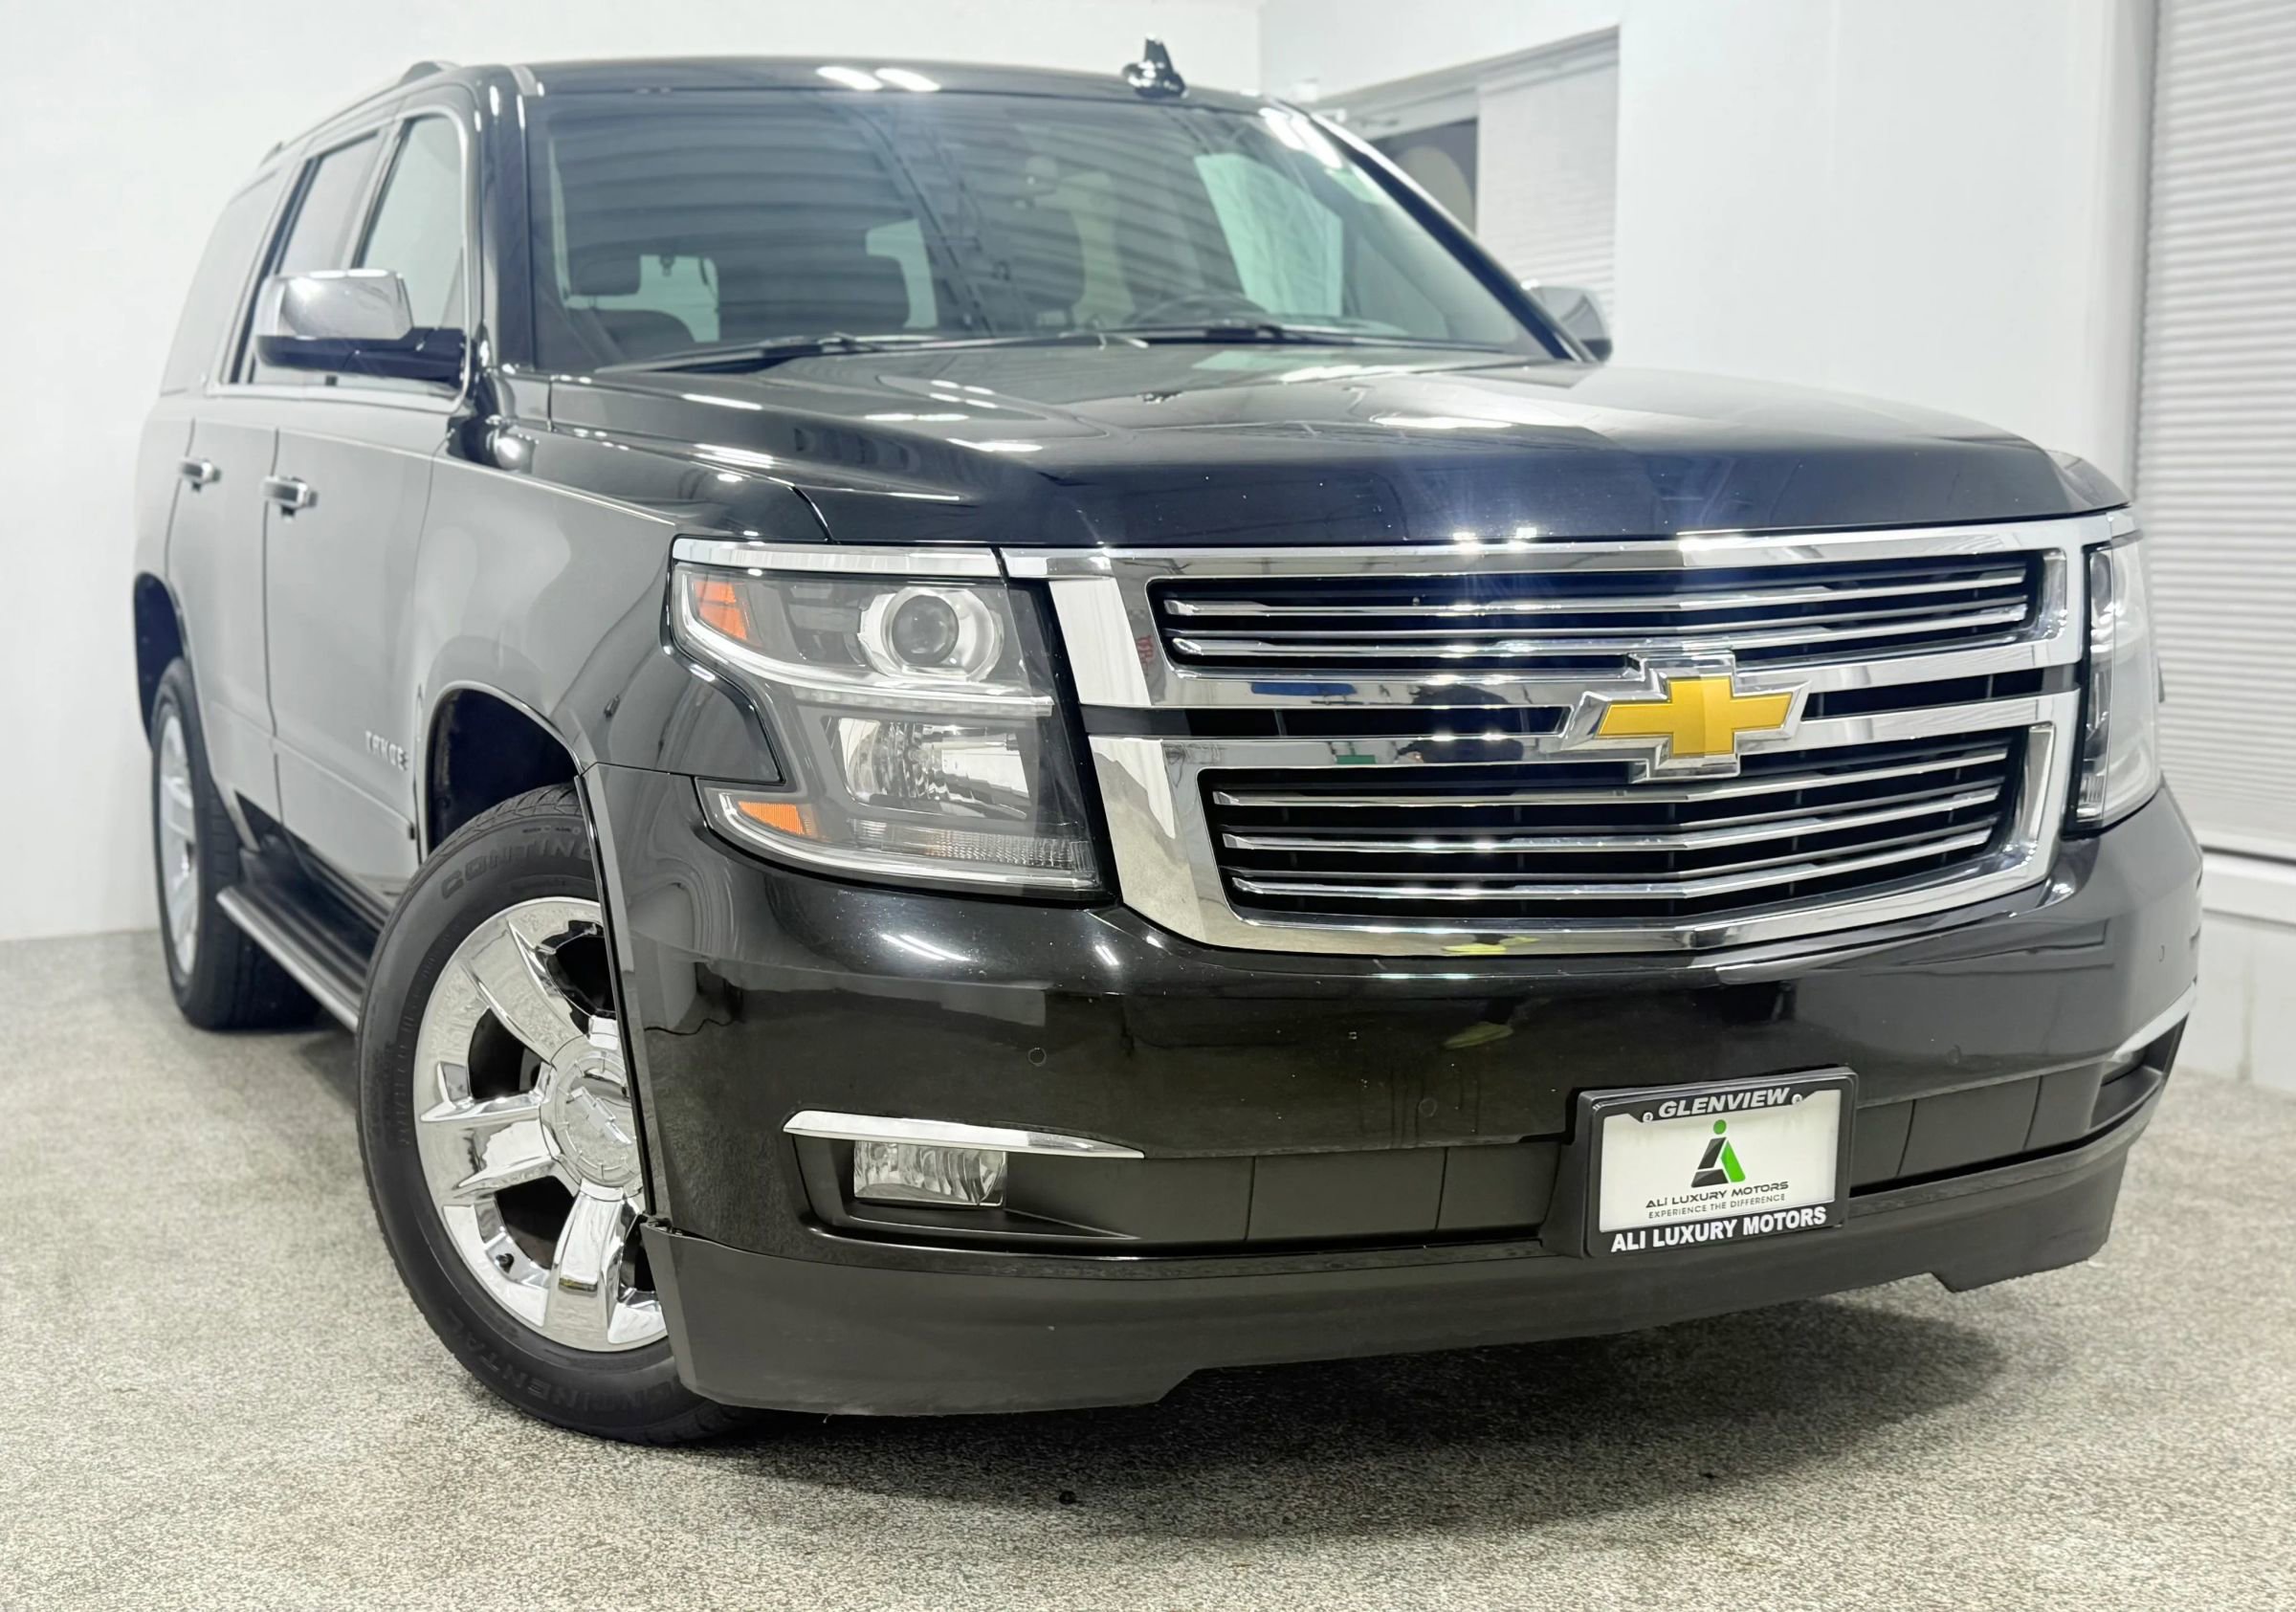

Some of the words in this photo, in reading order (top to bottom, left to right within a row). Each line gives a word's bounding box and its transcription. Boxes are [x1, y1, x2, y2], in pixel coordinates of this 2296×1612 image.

[1658, 1087, 1791, 1118] GLENVIEW
[1648, 1204, 1708, 1219] EXPERIENCE
[1710, 1201, 1727, 1211] THE
[1730, 1194, 1785, 1208] DIFFERENCE
[1671, 1190, 1727, 1205] LUXURY
[1731, 1181, 1789, 1196] MOTORS
[1610, 1230, 1645, 1253] ALI
[1652, 1219, 1738, 1248] LUXURY
[1743, 1206, 1827, 1236] MOTORS
